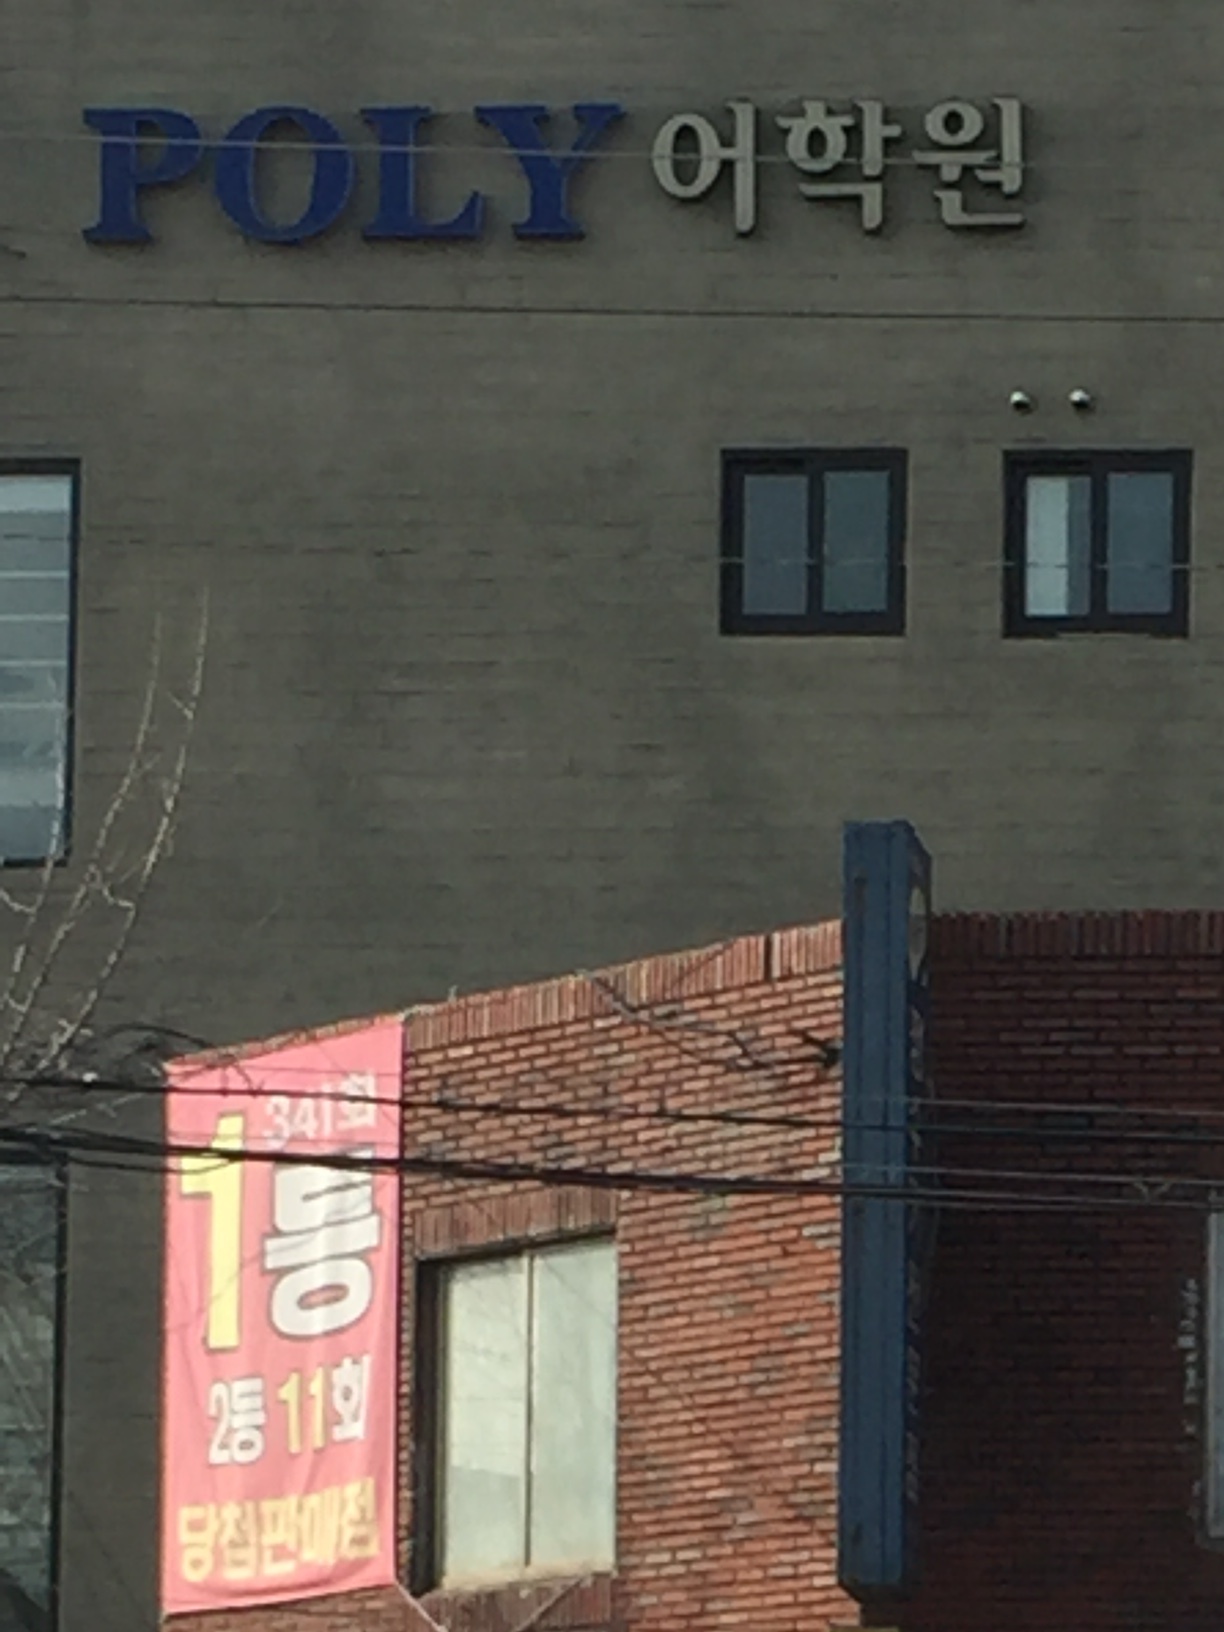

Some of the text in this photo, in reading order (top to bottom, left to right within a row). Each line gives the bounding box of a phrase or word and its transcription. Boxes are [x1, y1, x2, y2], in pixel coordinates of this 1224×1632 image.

[81, 96, 1028, 245] POLY 어학원
[178, 1112, 381, 1351] 1등
[207, 1374, 266, 1467] 2등
